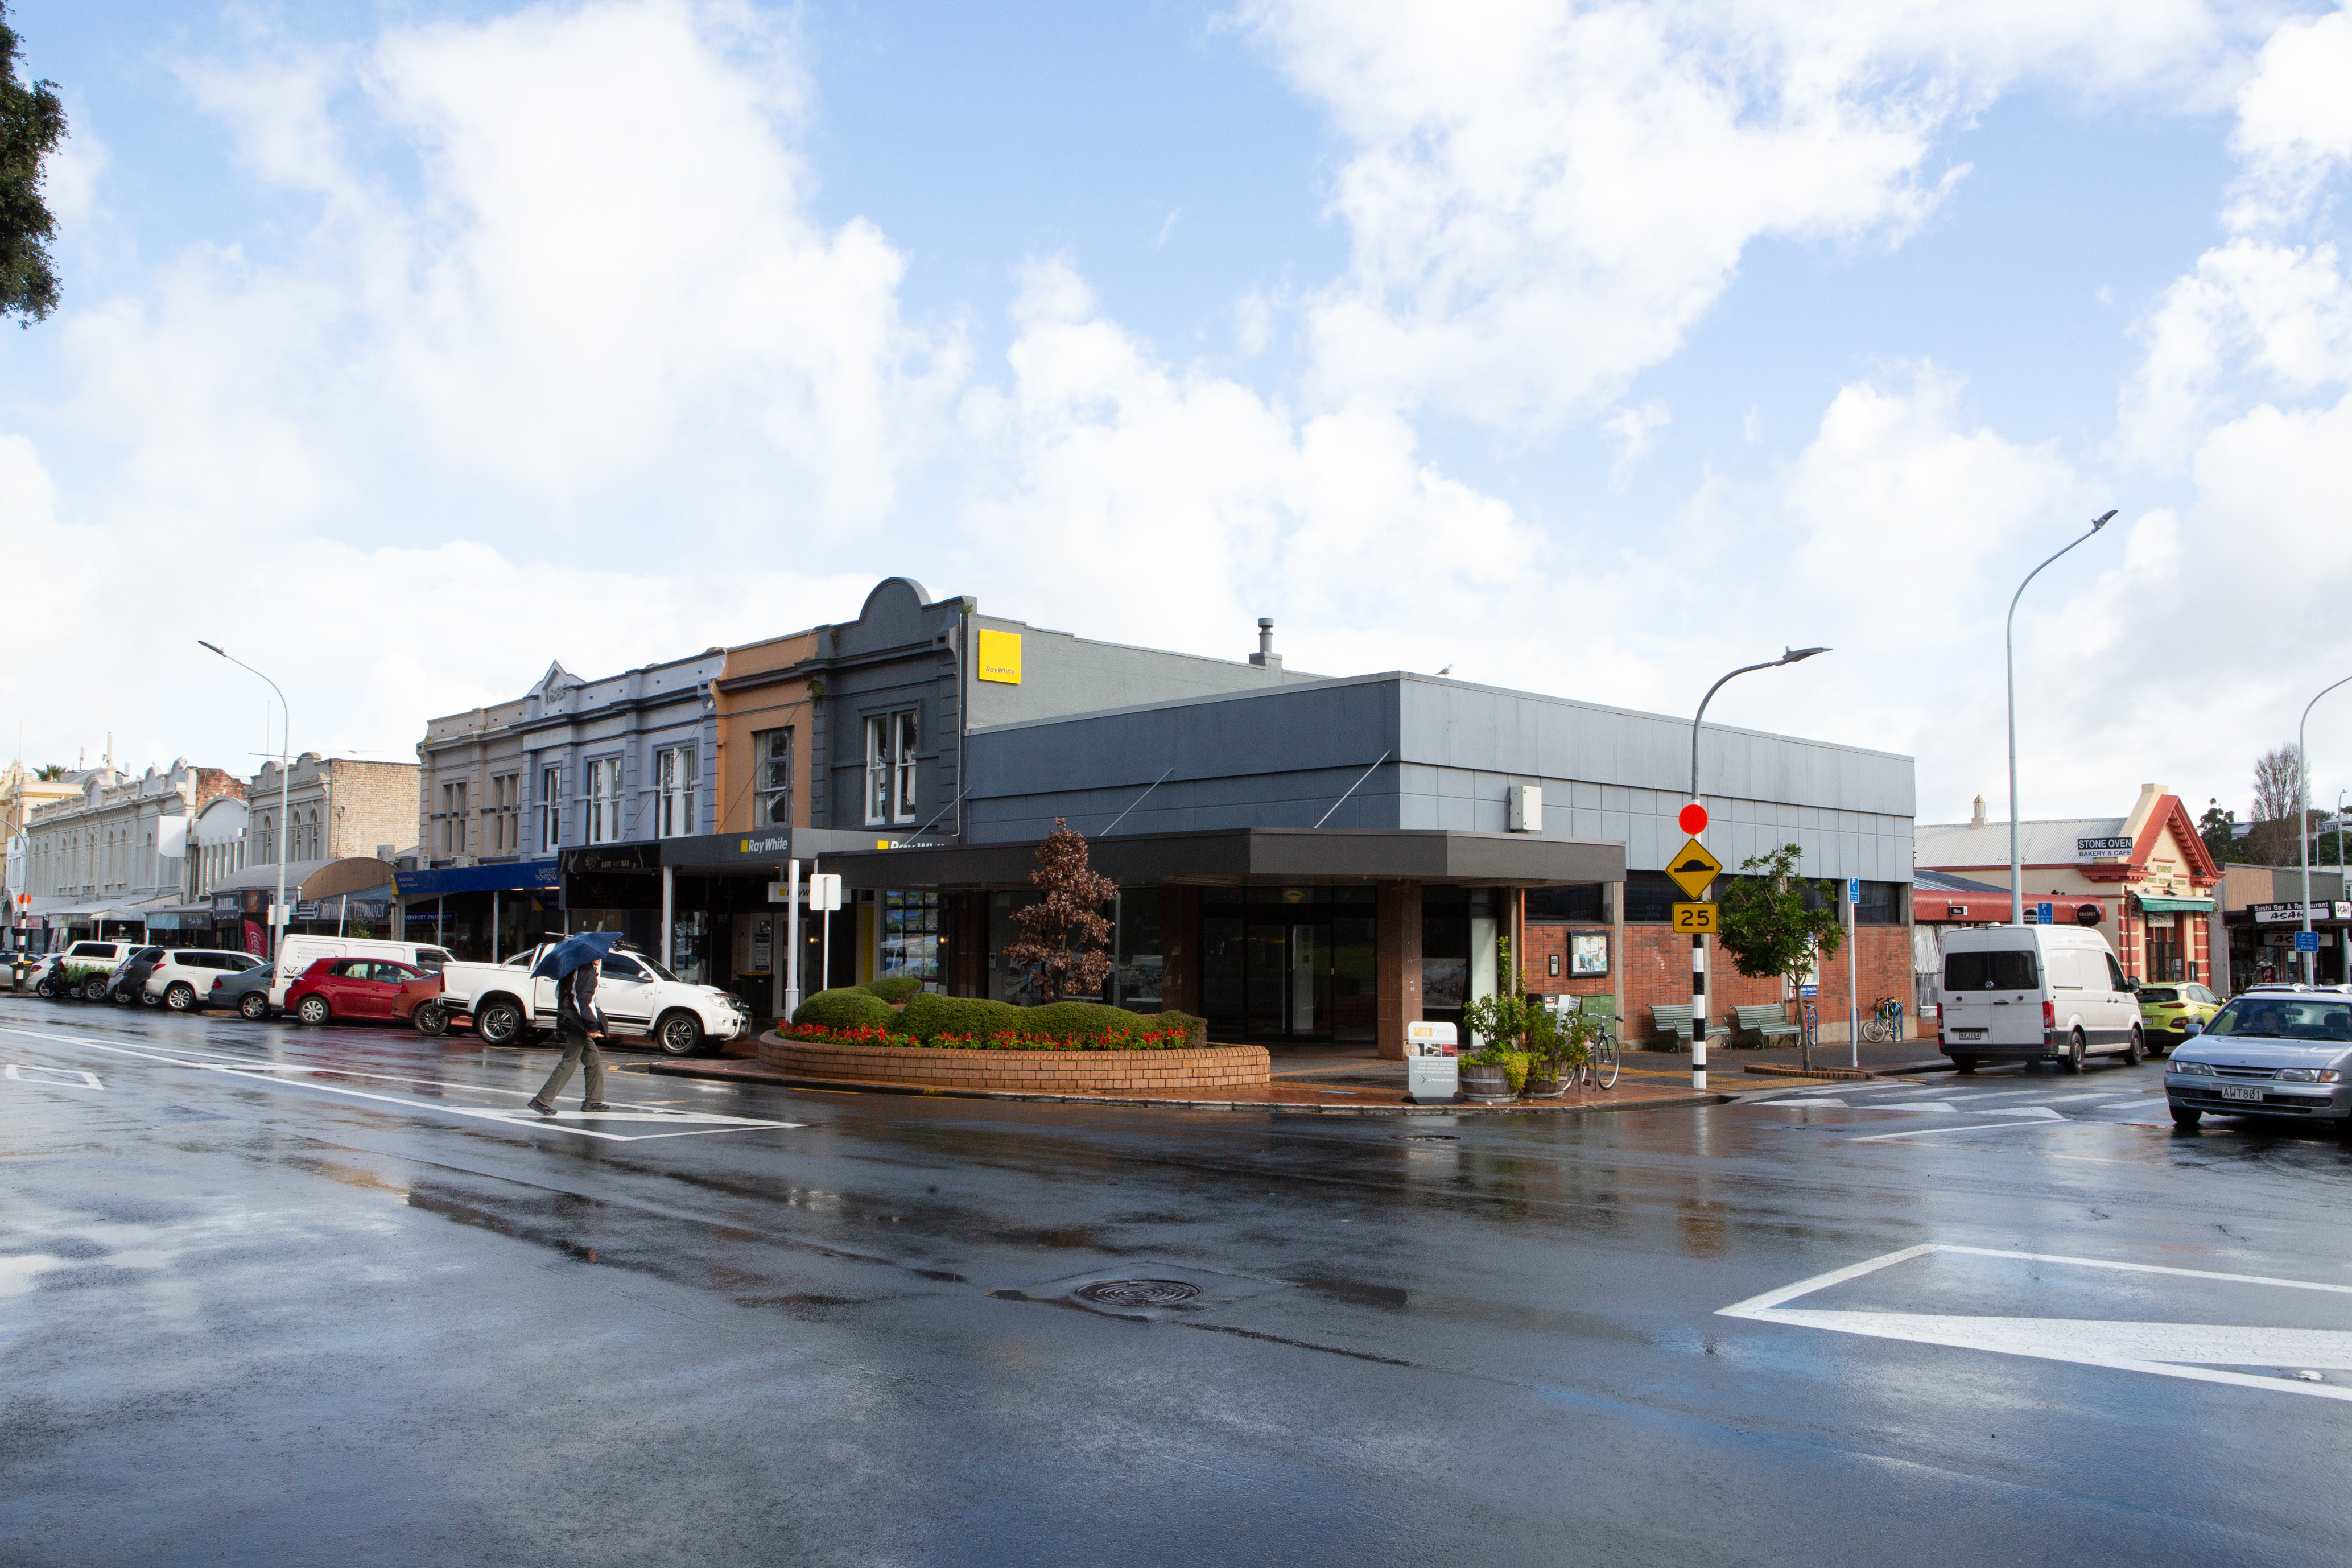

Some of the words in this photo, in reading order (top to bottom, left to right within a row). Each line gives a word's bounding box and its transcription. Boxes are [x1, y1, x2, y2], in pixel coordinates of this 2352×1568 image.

[748, 839, 764, 854] Ray
[765, 837, 788, 851] White
[2078, 840, 2106, 848] STONE
[2108, 839, 2131, 848] OVEN
[320, 903, 352, 917] DEVONPRT
[354, 903, 385, 918] PHARMACY
[2270, 911, 2303, 920] ASAH
[2337, 905, 2350, 915] ASAHI
[1681, 910, 1710, 926] 25
[1434, 1028, 1451, 1037] firefly
[2223, 1087, 2260, 1100] AWT801
